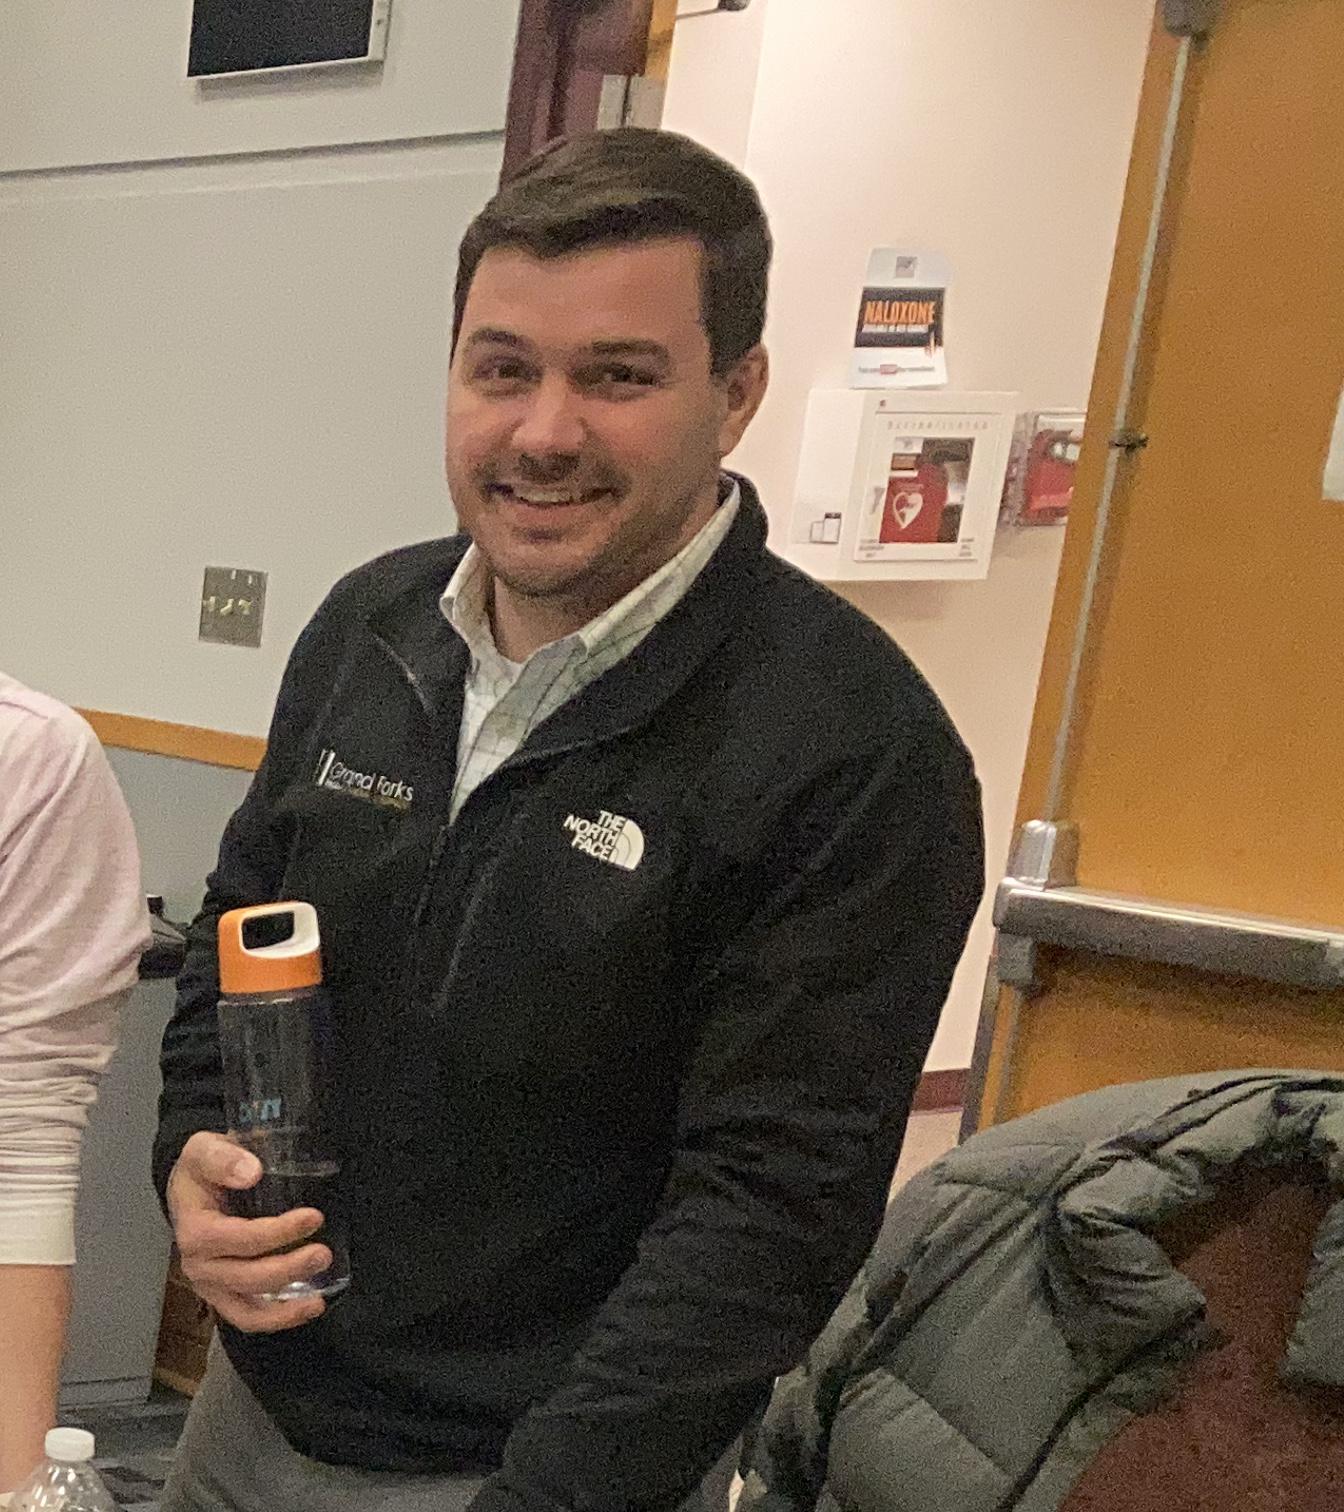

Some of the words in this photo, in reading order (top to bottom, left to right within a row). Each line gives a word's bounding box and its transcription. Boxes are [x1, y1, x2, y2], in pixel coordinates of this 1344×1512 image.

[863, 300, 936, 325] NALOXONE
[330, 761, 376, 791] Grand
[377, 775, 415, 802] Forks
[563, 814, 621, 847] NORTH
[597, 809, 627, 832] THE
[572, 832, 613, 861] FACE
